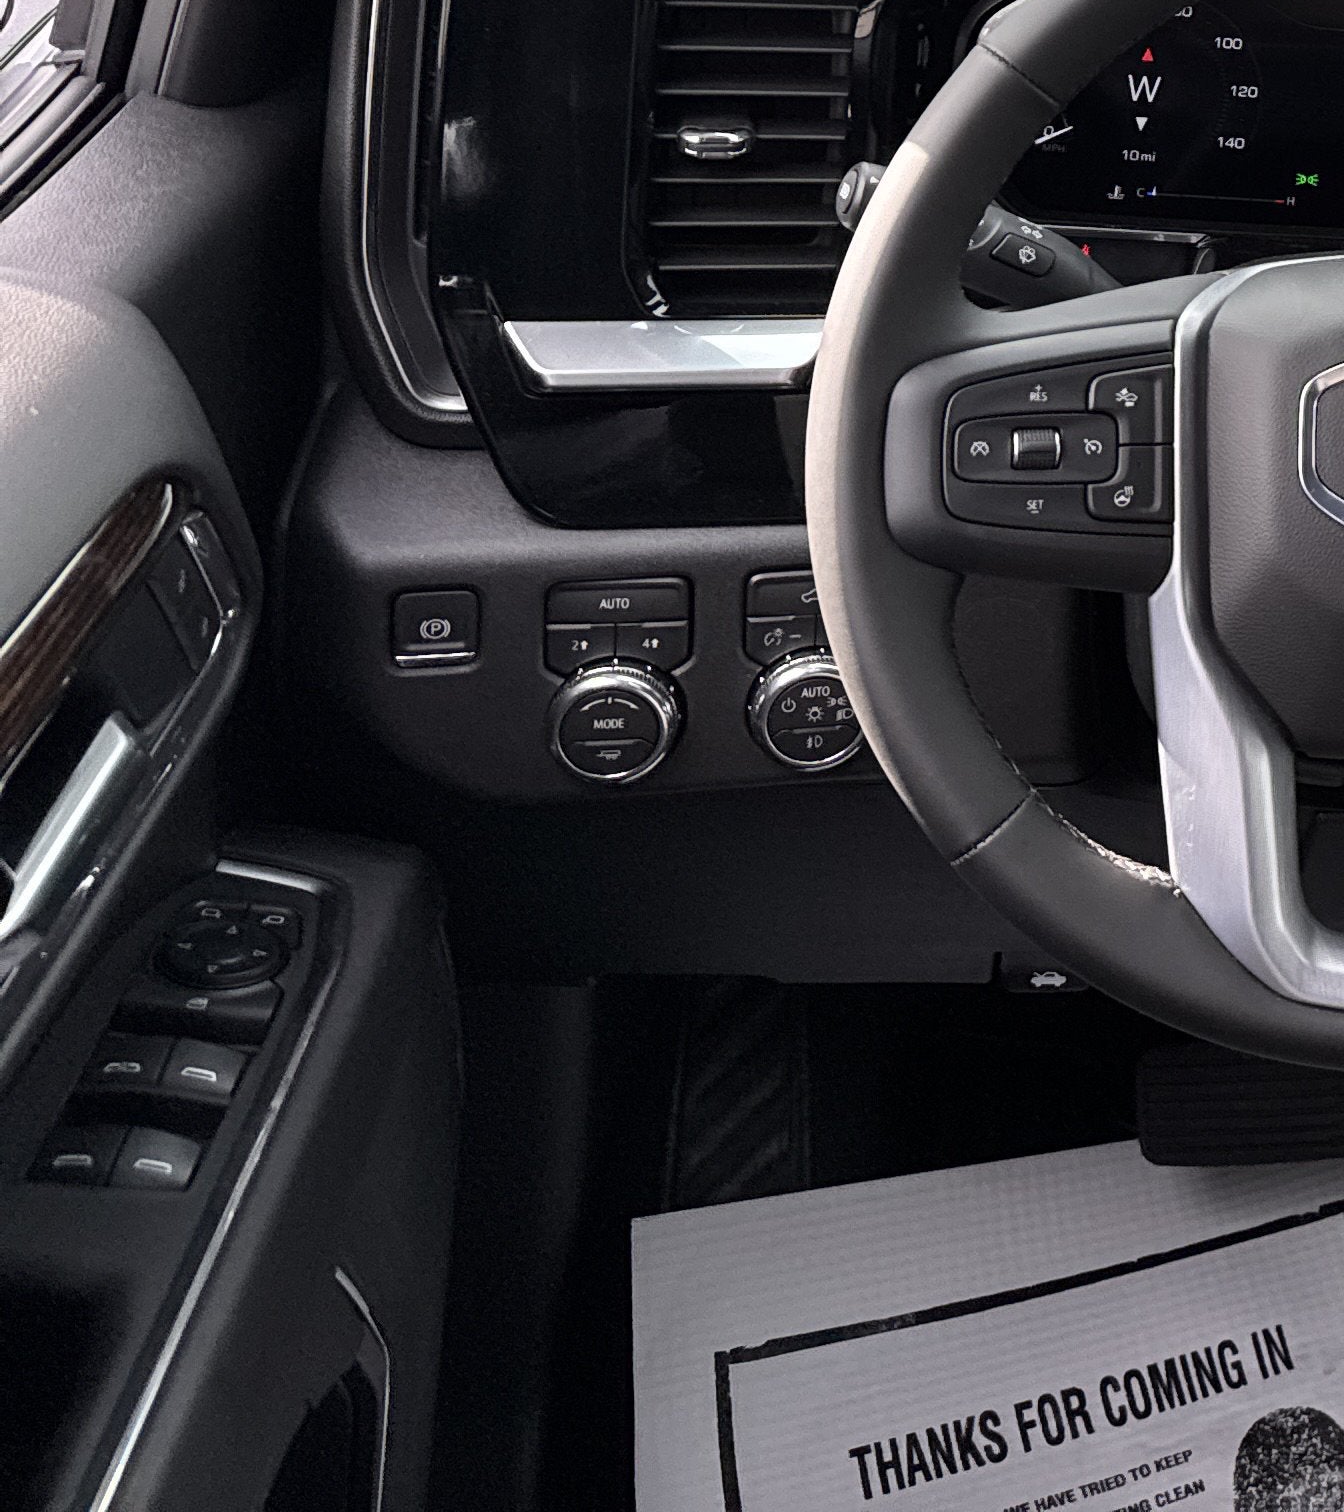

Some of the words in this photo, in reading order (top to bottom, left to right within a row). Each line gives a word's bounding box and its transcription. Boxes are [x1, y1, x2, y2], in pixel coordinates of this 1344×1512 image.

[1214, 37, 1243, 50] 100
[1128, 74, 1162, 103] W
[1230, 85, 1259, 99] 120
[1217, 136, 1246, 150] 140
[1287, 197, 1296, 206] H
[1026, 499, 1044, 510] SET
[599, 597, 630, 611] AUTO
[801, 686, 831, 699] AUTO
[593, 717, 625, 730] MODE
[848, 1410, 1009, 1501] THANKS
[1014, 1386, 1095, 1453] FOR
[1099, 1338, 1249, 1427] COMING
[1251, 1324, 1296, 1380] IN
[1033, 1489, 1077, 1512] HAVE
[1078, 1473, 1127, 1498] TRIED
[1128, 1463, 1152, 1481] TO
[1154, 1449, 1193, 1473] KEEP
[1154, 1479, 1206, 1508] CLEAN
